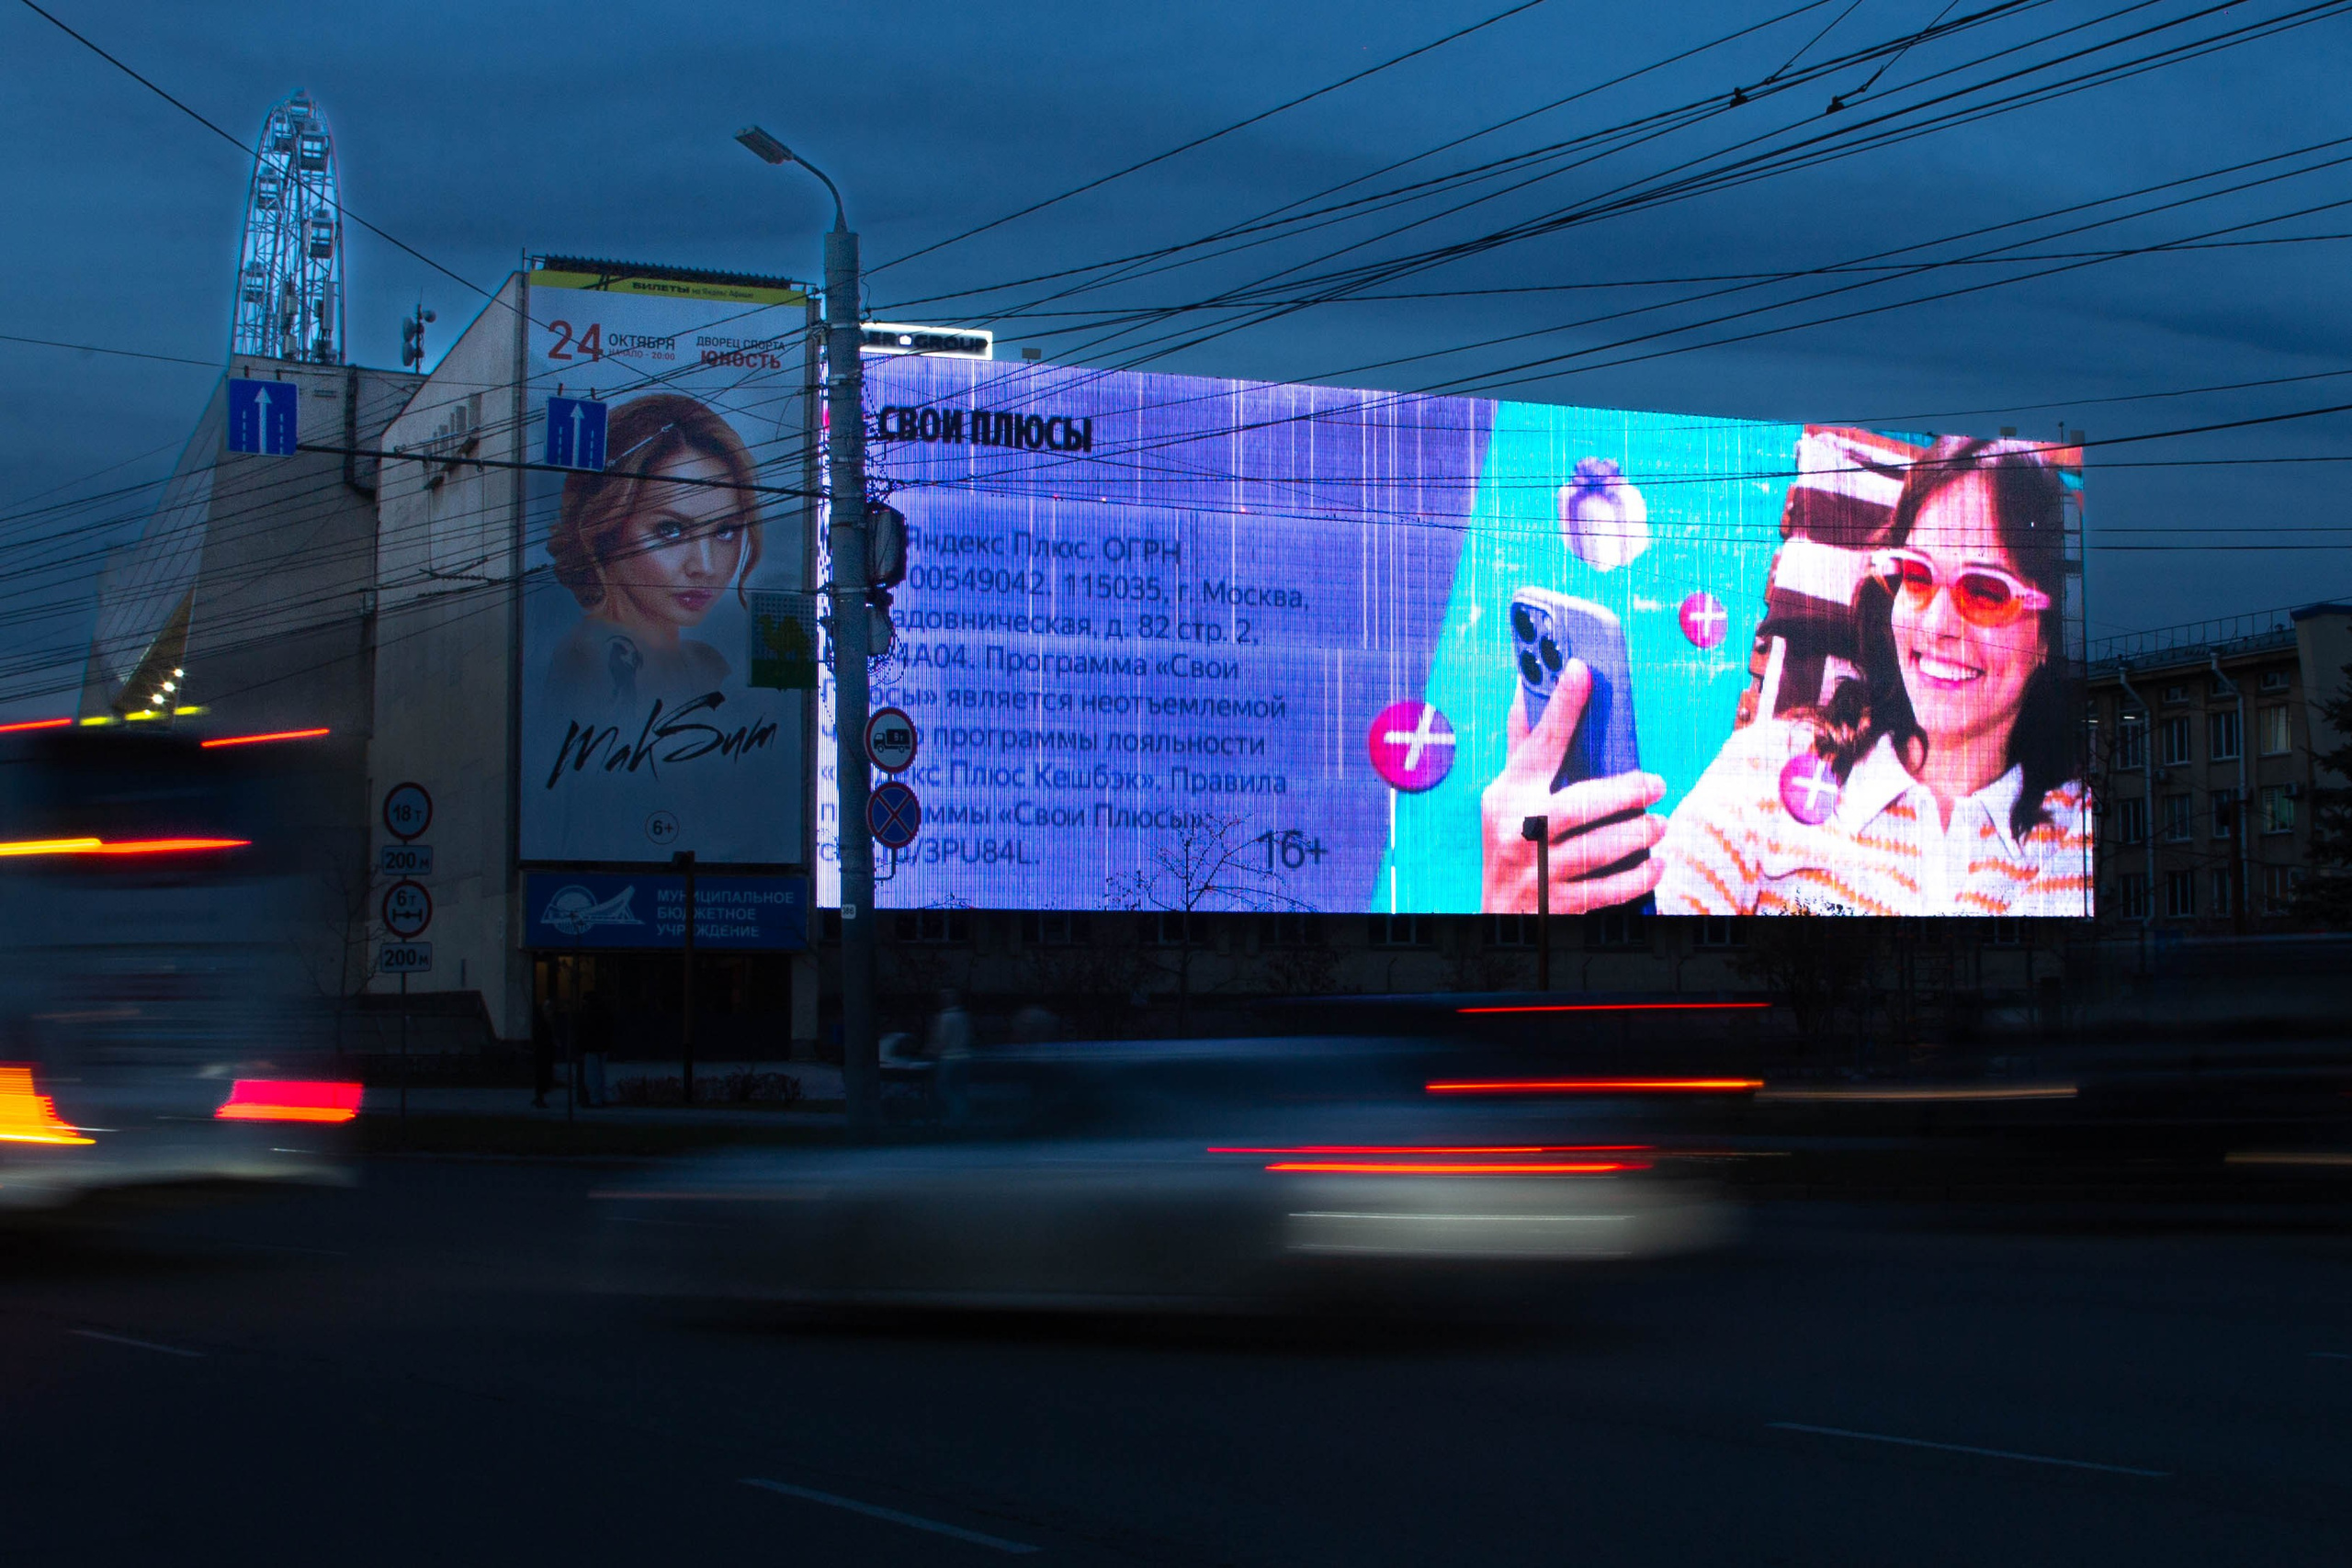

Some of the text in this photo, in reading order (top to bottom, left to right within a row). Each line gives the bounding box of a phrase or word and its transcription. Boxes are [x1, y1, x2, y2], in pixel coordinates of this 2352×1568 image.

[631, 282, 690, 294] БИЛЕТЫ
[548, 320, 675, 362] 24 ОКТЯБРЯ
[696, 336, 786, 351] ДВОРЕЦ СПОРТА
[913, 333, 989, 352] GROUP
[701, 350, 781, 369] ЮНОСТЬ
[879, 405, 1092, 453] СВОИ ПЛЮСЫ
[1104, 536, 1182, 564] ОГРН
[1203, 579, 1309, 612] Москва,
[891, 609, 1097, 640] адовническая,
[1107, 617, 1129, 641] д.
[1139, 615, 1170, 639] 82
[1178, 622, 1227, 646] стр.
[987, 644, 1147, 678] Программа
[1156, 653, 1238, 680] «Свои
[946, 689, 1073, 712] является
[1081, 694, 1285, 718] неотъемлемой
[933, 728, 1097, 752] программы
[1106, 733, 1265, 755] лояльности
[951, 760, 1025, 787] Плюс
[1171, 766, 1286, 795] Правила
[393, 805, 412, 822] 18
[1001, 801, 1085, 828] «Свои
[651, 819, 673, 836] 6+
[386, 852, 416, 869] 200
[1262, 829, 1329, 870] 16+
[397, 889, 406, 907] 6
[656, 906, 757, 921] БЮЖЕТНОЕ
[656, 922, 761, 939] УЧРЖДЕНИЕ
[385, 949, 416, 966] 200
